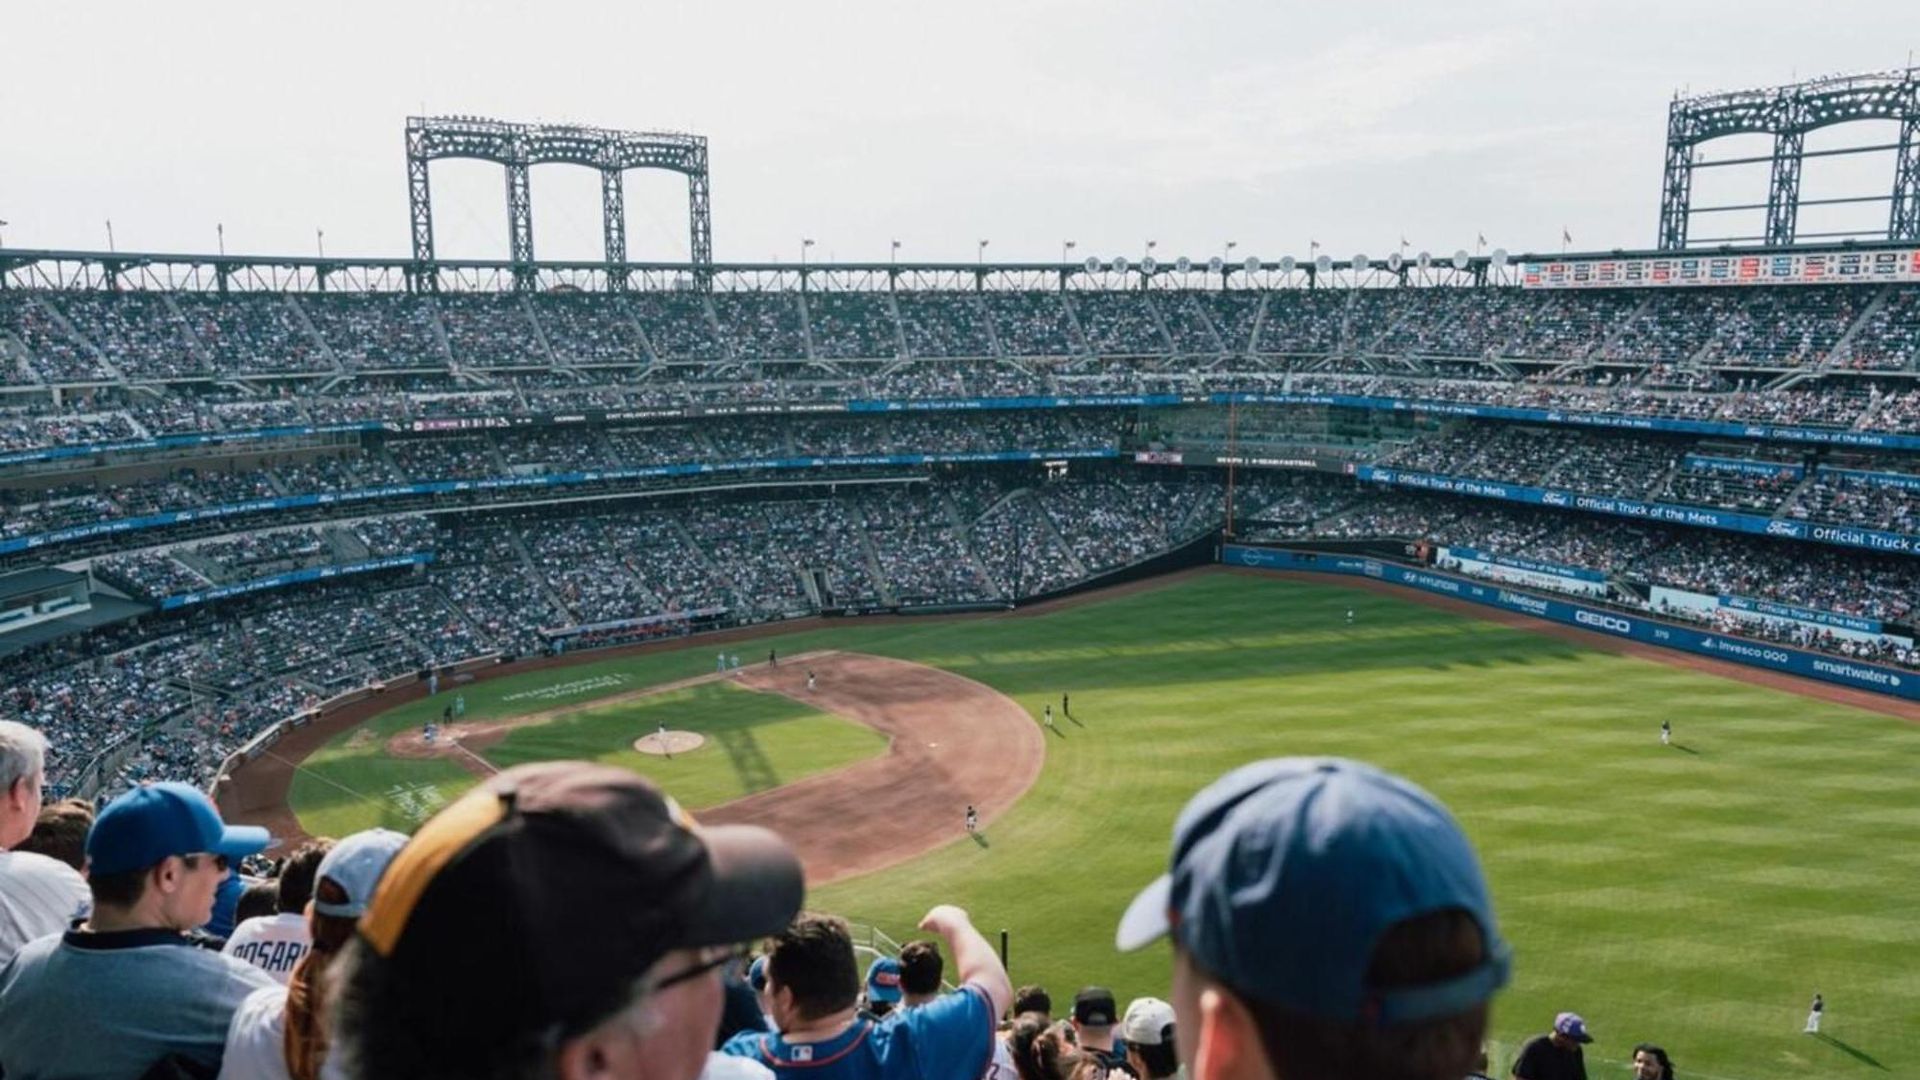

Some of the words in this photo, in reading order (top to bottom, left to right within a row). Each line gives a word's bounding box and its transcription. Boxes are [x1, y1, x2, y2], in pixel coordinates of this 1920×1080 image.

[1772, 429, 1802, 438] Official
[1806, 431, 1828, 440] Truck
[1831, 433, 1840, 441] of
[1842, 434, 1856, 443] the
[1860, 435, 1882, 444] Mets
[1372, 469, 1389, 481] Ford
[1398, 473, 1428, 486] Official
[1430, 478, 1452, 489] Truck
[1454, 481, 1464, 491] of
[1466, 483, 1481, 493] the
[1482, 485, 1505, 497] Mets
[1542, 492, 1565, 505] Ford
[1576, 497, 1614, 511] Official
[1618, 502, 1646, 515] Truck
[1649, 506, 1662, 517] of
[1664, 508, 1683, 520] the
[1687, 511, 1716, 524] Mets
[1766, 519, 1798, 536] Ford
[1813, 526, 1864, 544] Official
[1871, 534, 1910, 551] Truck
[1509, 594, 1547, 610] National
[1576, 610, 1630, 632] GEICO
[1757, 604, 1788, 615] Official
[1790, 610, 1813, 619] Truck
[1828, 616, 1843, 624] the
[1845, 619, 1869, 628] Mets
[1719, 640, 1761, 657] Invesco
[1763, 651, 1788, 663] QQQ
[1813, 660, 1888, 684] smartwater
